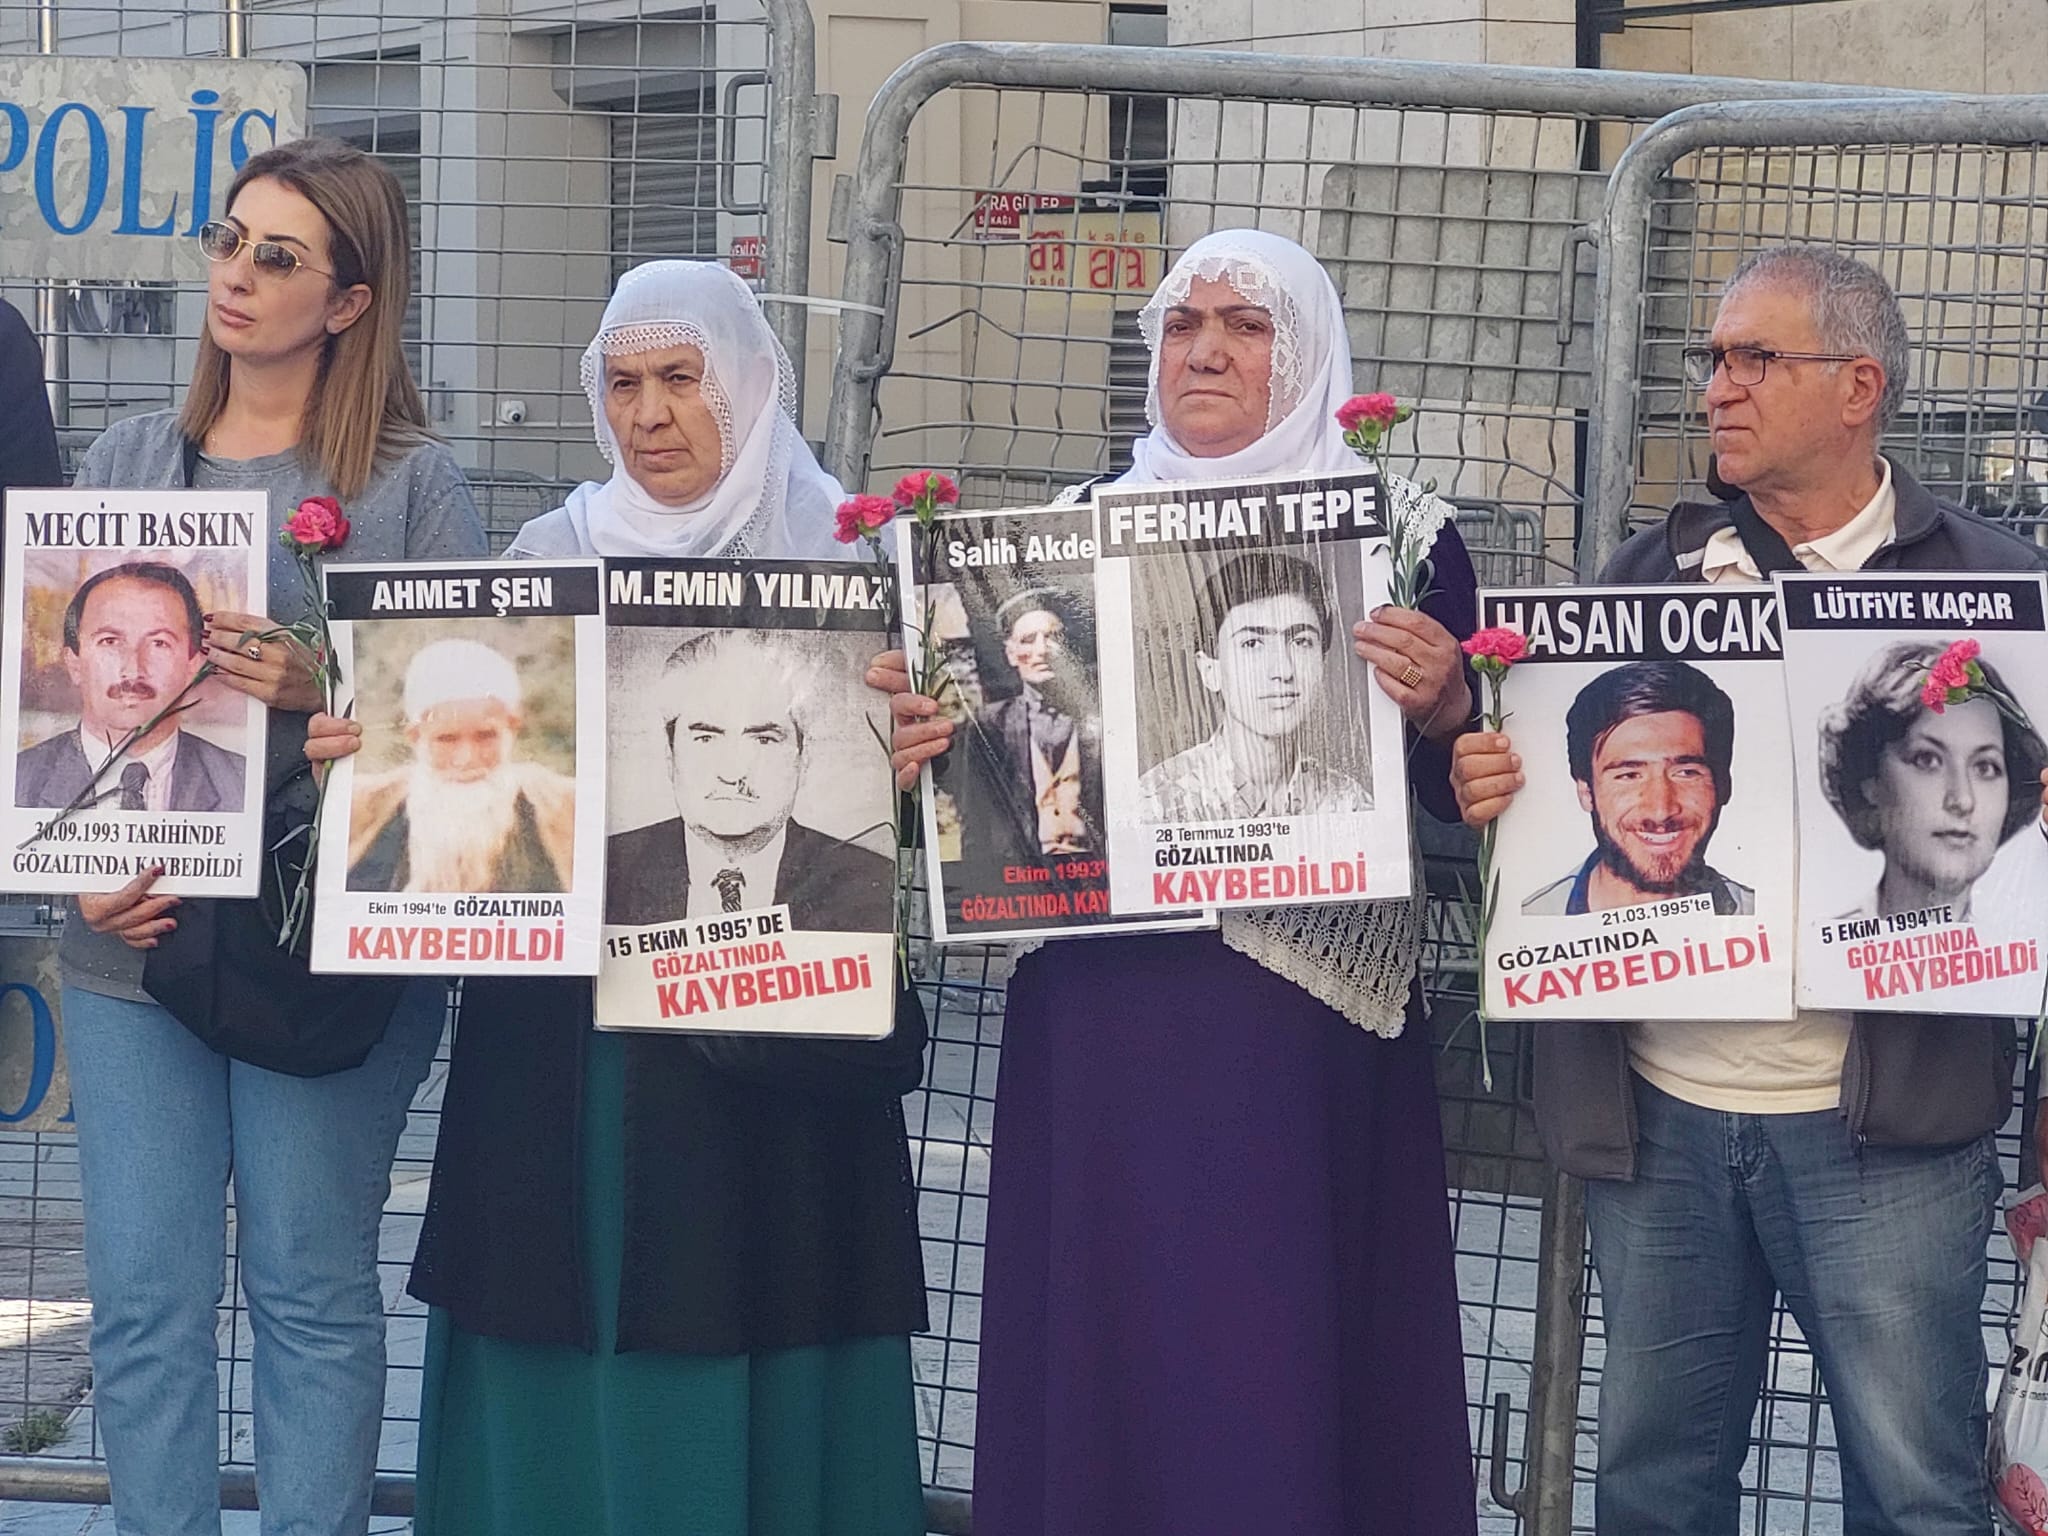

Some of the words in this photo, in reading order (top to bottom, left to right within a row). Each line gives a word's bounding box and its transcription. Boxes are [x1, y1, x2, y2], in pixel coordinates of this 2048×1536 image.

[978, 214, 1012, 226] SKAĞI
[24, 502, 129, 547] MECİT
[137, 511, 255, 547] BASKIN
[1108, 497, 1266, 545] FERHAT
[1276, 486, 1378, 533] TEPE
[948, 537, 1018, 568] Salih
[371, 578, 481, 611] AHMET
[491, 577, 553, 617] ŞEN
[753, 572, 893, 610] YILMAZ
[1921, 591, 2014, 627] KAÇAR
[1660, 598, 1782, 654] OCAK
[34, 821, 120, 843] 30.09.1993
[125, 818, 226, 846] TARİHİNDE
[1155, 829, 1173, 843] 28
[1177, 826, 1235, 842] Temmuz
[1238, 822, 1291, 838] 1993'te
[13, 847, 130, 876] GÖZALTINDA
[1003, 864, 1050, 884] Ekim
[1155, 843, 1274, 868] GÖZALTINDA
[1153, 851, 1368, 905] KAYBEDİLDİ
[368, 901, 399, 915] Ekim
[402, 901, 447, 916] 1994'te
[453, 895, 565, 918] GÖZALTINDA
[961, 892, 1071, 922] GÖZALTINDA
[1601, 898, 1711, 926] 21.03.1995'te
[1821, 926, 1833, 945] 5
[1886, 905, 1953, 933] 1994'TE
[347, 919, 565, 962] KAYBEDİLDİ
[606, 936, 632, 958] 15
[757, 912, 785, 935] DE
[1498, 927, 1659, 971] GÖZALTINDA
[1847, 927, 1979, 969] GÖZALTINDA
[651, 940, 787, 980] GÖZALTINDA
[1503, 923, 1772, 1009] KAYBEDİLDİ
